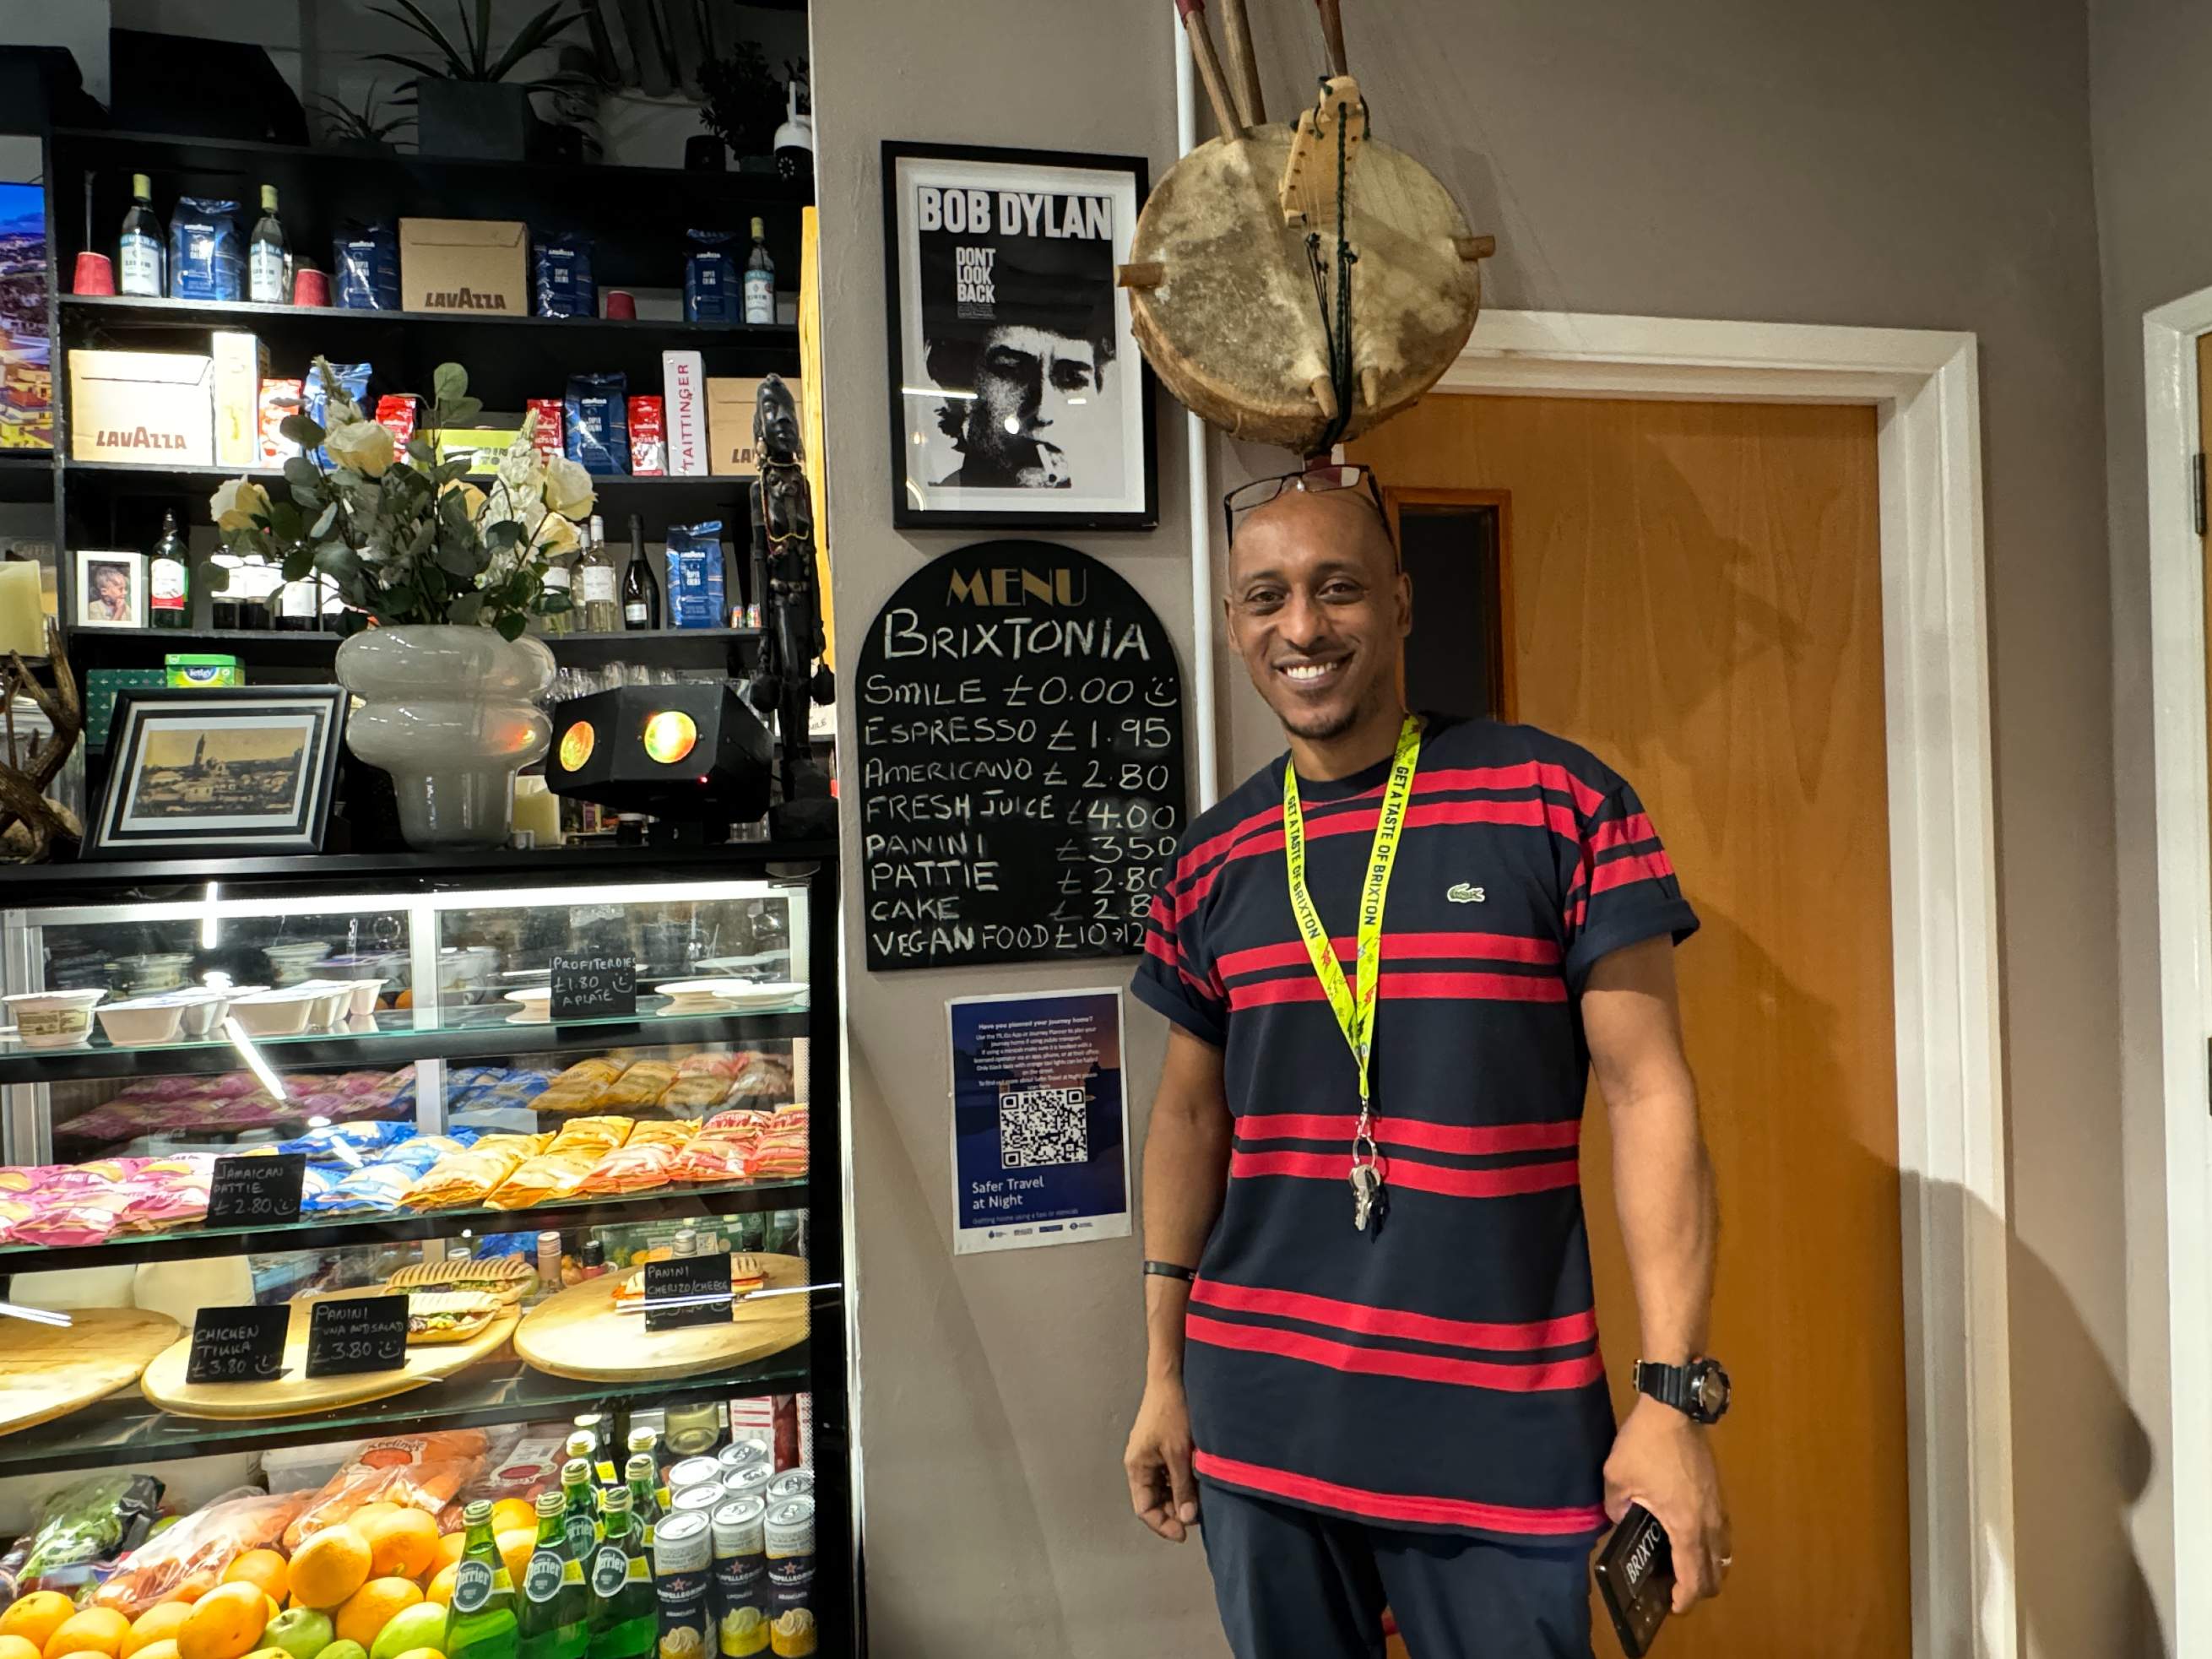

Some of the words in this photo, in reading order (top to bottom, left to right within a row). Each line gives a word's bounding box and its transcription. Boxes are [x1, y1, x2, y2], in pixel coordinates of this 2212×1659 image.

[919, 187, 991, 233] BOB
[999, 192, 1113, 240] DYLAN
[956, 247, 996, 266] DONT
[957, 265, 992, 285] LOOK
[425, 287, 507, 310] LAVAZZA
[957, 284, 995, 304] BACK
[677, 364, 696, 467] TAITTINGER
[96, 426, 187, 450] LAVAZZA
[946, 567, 1087, 607] MENU
[884, 608, 1151, 661] BRIXTONIA
[865, 716, 1037, 746] ESPRESSO
[1394, 766, 1409, 789] GET
[866, 794, 971, 825] FRESH
[979, 789, 1054, 819] JUICE
[1286, 795, 1298, 819] GET
[1391, 791, 1403, 800] A
[1289, 819, 1298, 829] A
[1381, 802, 1401, 840] TASTE
[866, 831, 984, 859] PANINI
[1289, 830, 1301, 864] TASTE
[1376, 843, 1391, 863] OF
[871, 860, 999, 892] PATTIE
[1292, 865, 1302, 883] OF
[1364, 865, 1386, 925] BRIXTON
[870, 896, 960, 922] CAKE
[1293, 883, 1321, 939] BRIXTON
[873, 925, 976, 957] VEGAN
[982, 924, 1049, 949] FOOD
[575, 989, 613, 1006] PLATE
[972, 1181, 1004, 1194] Safer
[1007, 1175, 1044, 1190] Travel
[973, 1200, 985, 1210] at
[989, 1195, 1023, 1209] Night
[648, 1266, 689, 1278] PANINI
[316, 1306, 368, 1322] PANINI
[195, 1325, 259, 1343] CHICKEN
[1626, 1521, 1661, 1584] BRIXTO
